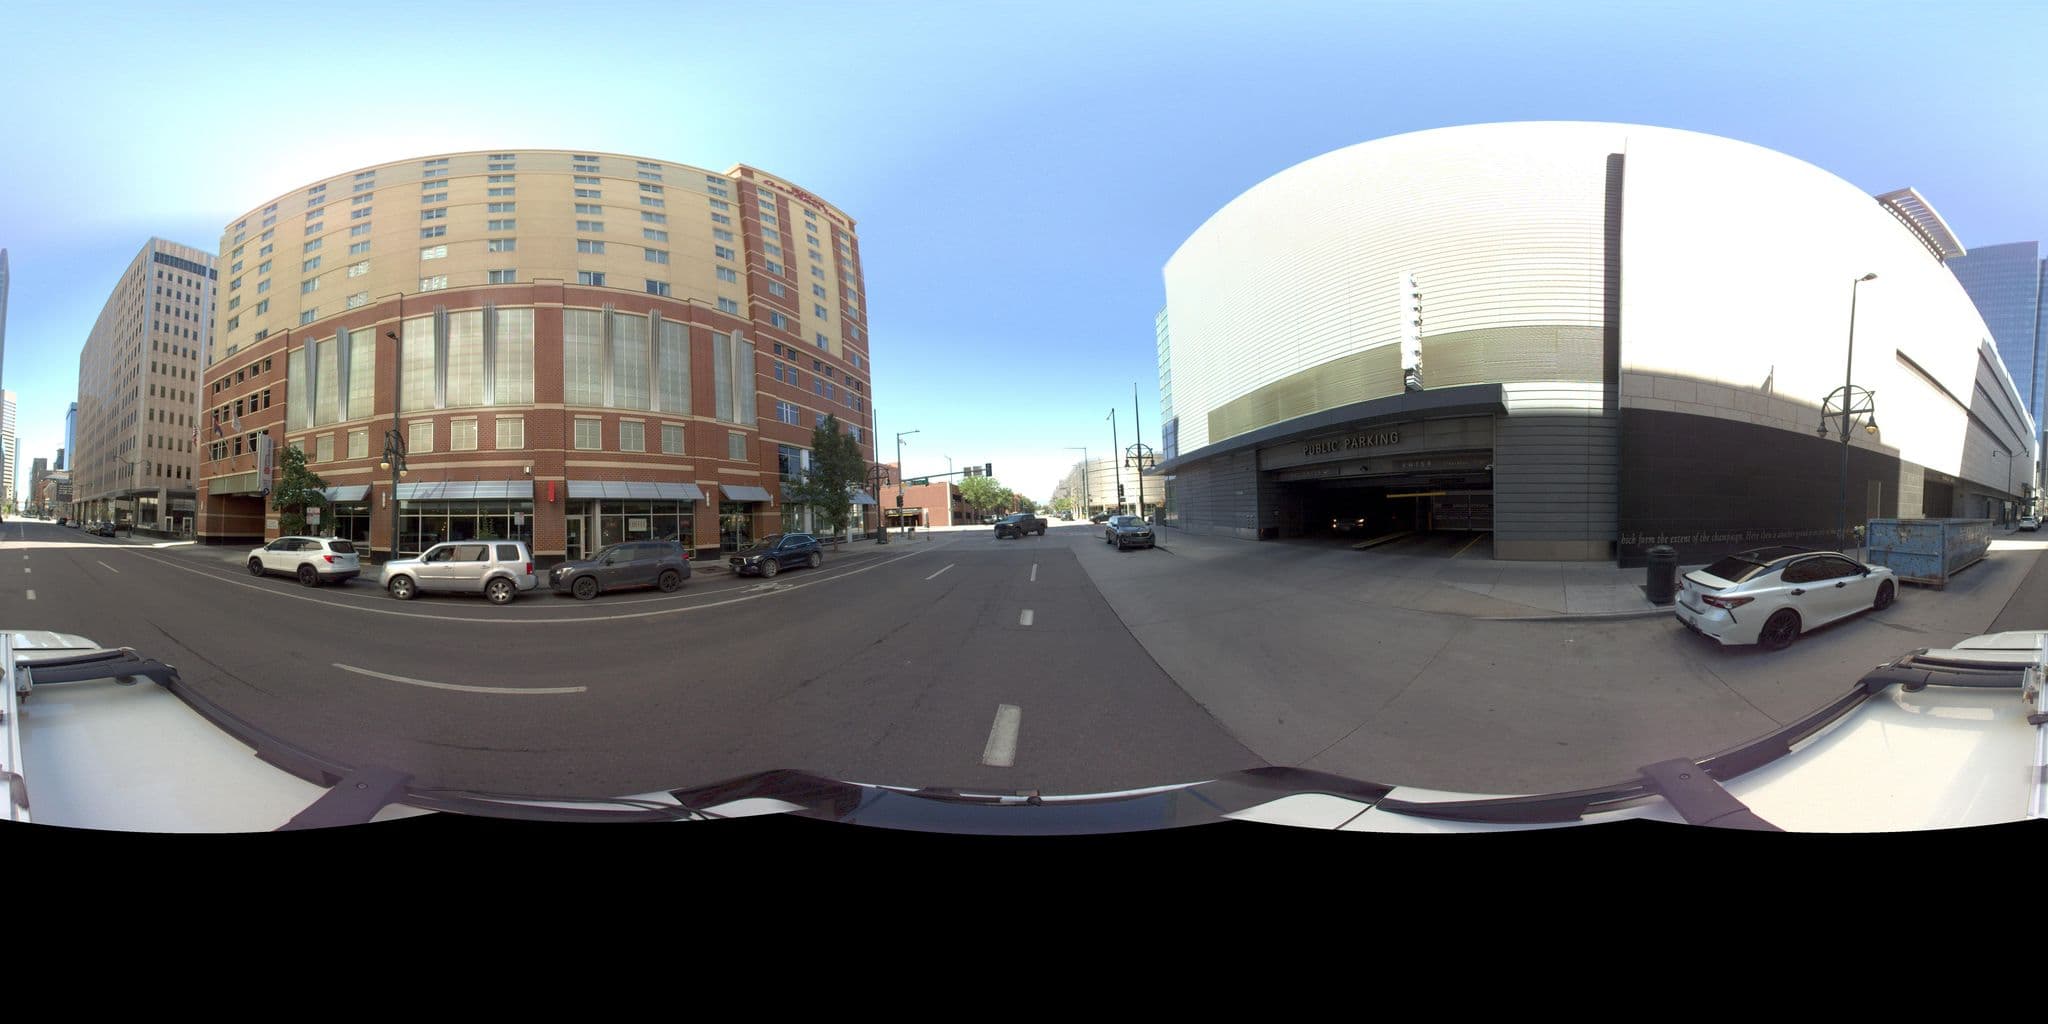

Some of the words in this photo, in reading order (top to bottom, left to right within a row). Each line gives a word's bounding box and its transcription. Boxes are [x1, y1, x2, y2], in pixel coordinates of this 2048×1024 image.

[1303, 440, 1338, 456] PUBLIC
[1344, 431, 1399, 449] PARKING
[1657, 531, 1669, 545] the
